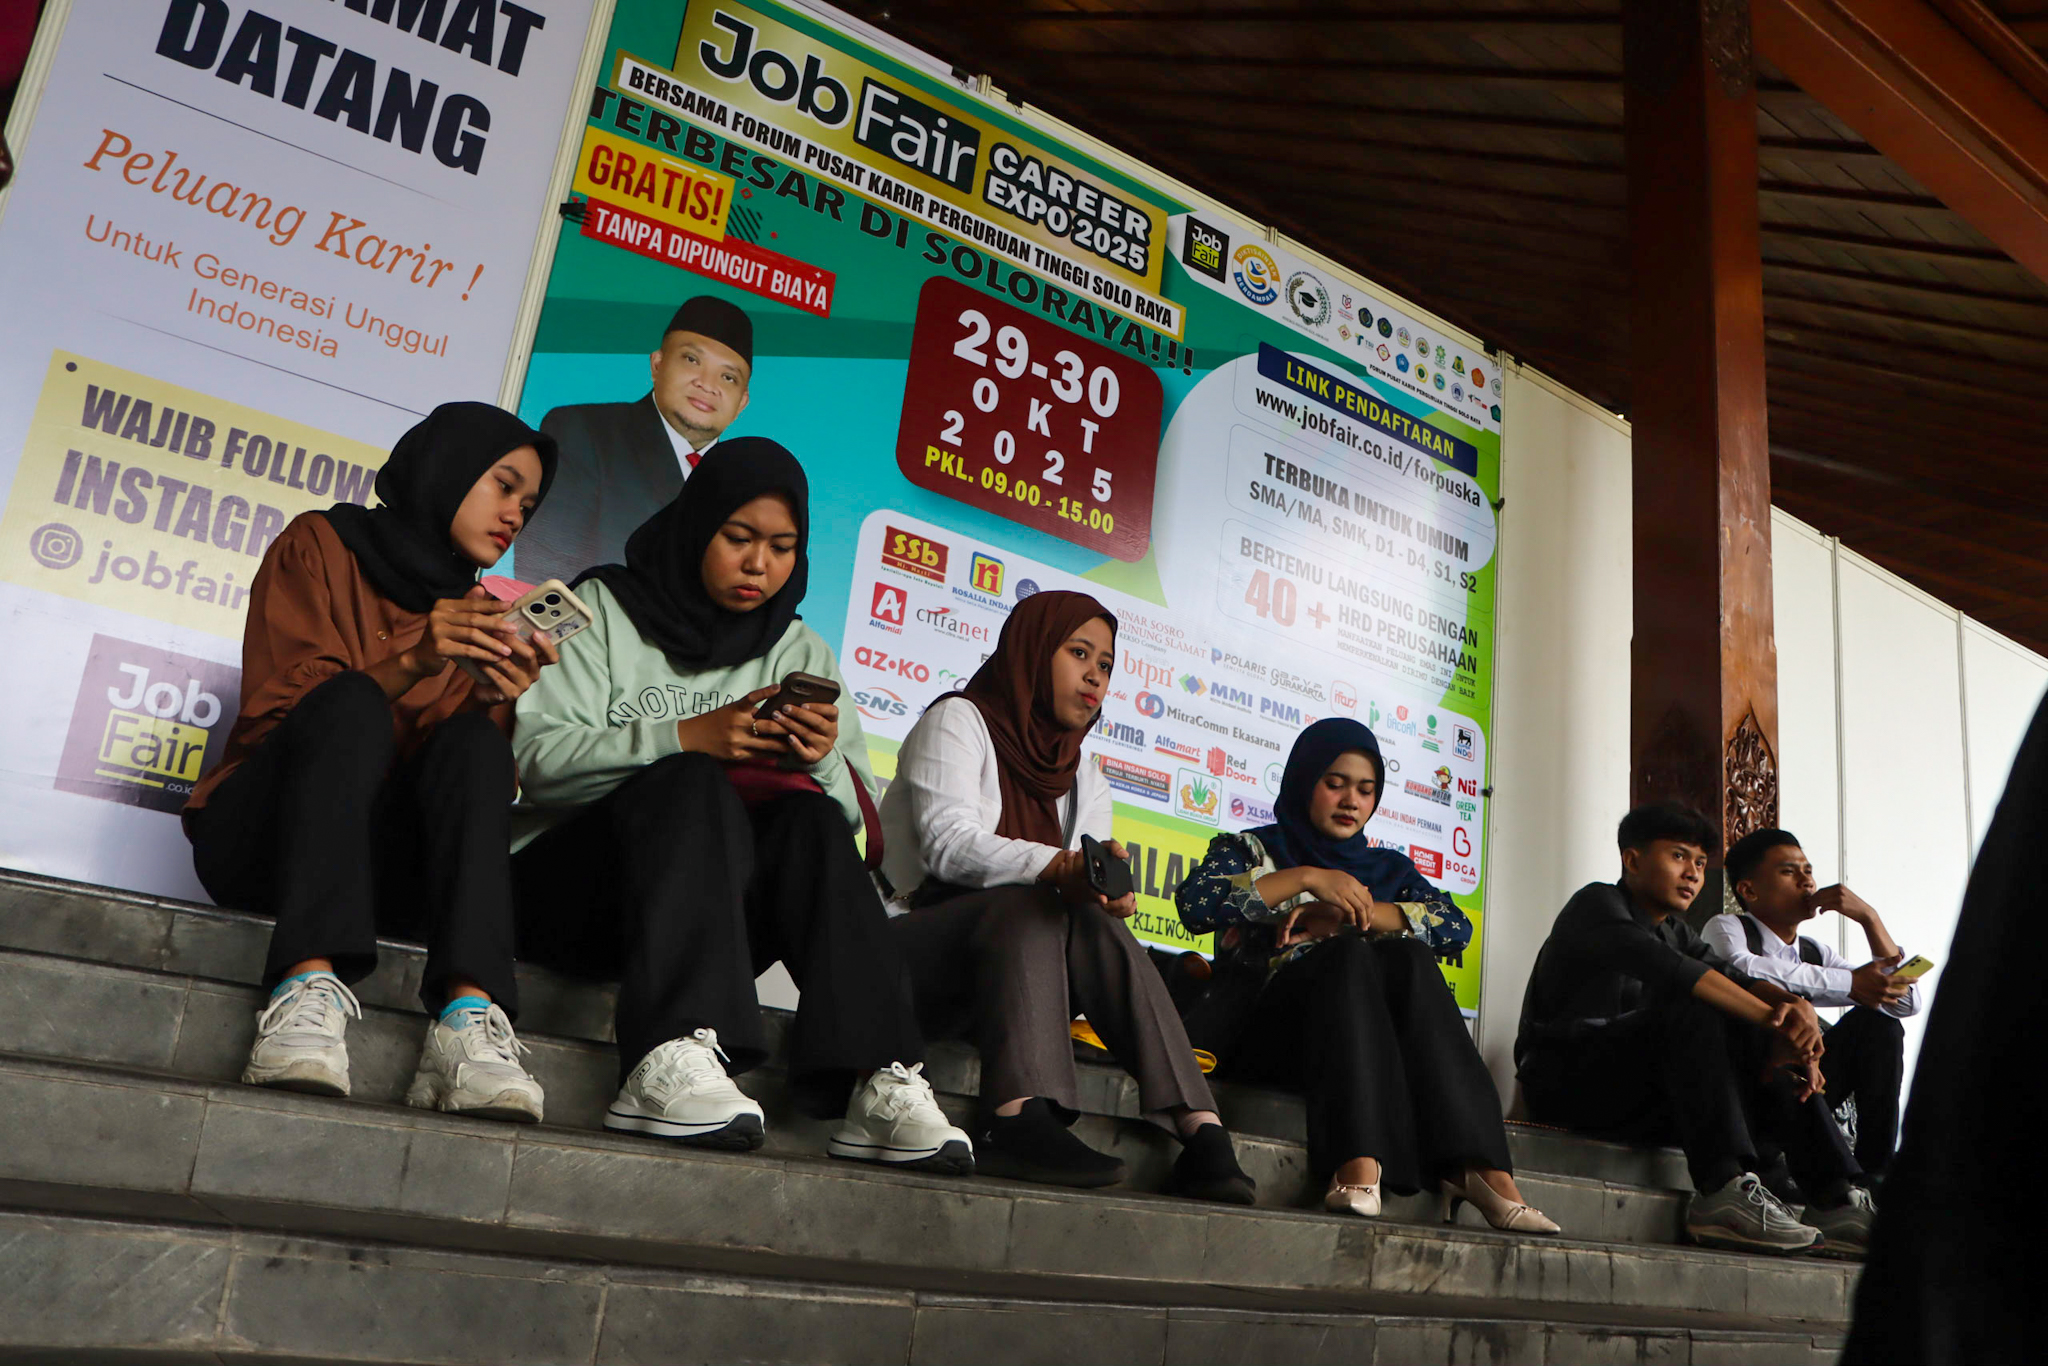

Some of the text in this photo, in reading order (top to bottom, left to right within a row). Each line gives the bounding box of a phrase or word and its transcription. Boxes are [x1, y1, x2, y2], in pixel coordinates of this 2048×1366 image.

[329, 0, 546, 77] MAT
[155, 0, 491, 176] DATANG
[700, 10, 976, 184] Job Fair
[588, 144, 724, 227] GRATIS!
[629, 66, 1172, 328] BERSAMA FORUM PUSAT KARIR PERGURUAN TINGGI SOLO RAYA
[992, 147, 1149, 243] CAREER
[83, 129, 307, 247] Peluang
[315, 211, 454, 294] Karir
[590, 85, 1195, 376] TERBESAR DI SOLORAYA!!!
[987, 177, 1146, 271] EXPO 2025
[596, 207, 827, 311] TANPA DIPUNGUT BIAYA
[1192, 225, 1223, 252] Job
[1193, 240, 1219, 269] Fair
[85, 214, 449, 358] Untuk Generasi Unggul
[188, 287, 340, 358] Indonesia
[953, 309, 1120, 418] 29-30
[1286, 361, 1455, 460] LINK PENDAFTARAN
[81, 384, 378, 507] WAJIB FOLLOW
[1255, 388, 1481, 508] www.jobfair.co.id/forpuska
[924, 444, 975, 483] PKL.
[981, 466, 1041, 507] 09.00
[1057, 496, 1115, 534] 15.00
[1264, 452, 1469, 561] TERBUKA UNTUK UMUM
[1250, 480, 1478, 594] SMA/MA, SMK, D1 D4, S1, S2
[952, 586, 987, 604] ROSALIA
[1240, 536, 1478, 649] BERTEMU LANGSUNG DENGAN
[1245, 568, 1298, 628] 40
[869, 619, 903, 635] Alfamidi
[916, 608, 989, 642] citranet
[1116, 608, 1185, 639] SINAR SOSRO
[1118, 633, 1167, 654] REKSO Company
[1338, 604, 1477, 674] HRD PERUSAHAAN
[1165, 637, 1208, 659] SLAMAT
[1223, 653, 1267, 676] POLARIS
[108, 662, 222, 728] Job
[1420, 659, 1436, 672] EMAS
[1440, 667, 1452, 678] INI
[1456, 673, 1476, 687] UNTUK
[1431, 676, 1456, 692] DENGAN
[1459, 686, 1476, 699] BAIK
[853, 691, 908, 716] SNS
[1210, 681, 1253, 708] MMI
[1260, 696, 1300, 725] PNM
[103, 713, 203, 775] Fair
[1155, 734, 1201, 757] Alfamart
[1167, 704, 1229, 736] MitraComm
[1232, 726, 1281, 752] Ekasarana
[1106, 758, 1123, 770] BINA
[1124, 764, 1147, 776] INSANI
[1147, 771, 1166, 782] SOLO
[1227, 754, 1247, 770] Red
[1455, 747, 1472, 759] INDO
[1226, 767, 1257, 786] Doorz
[1399, 812, 1417, 826] INDAH
[1417, 818, 1442, 834] PERMANA
[1455, 800, 1477, 813] GREEN
[1459, 811, 1472, 822] TEA
[1413, 849, 1434, 861] HOME
[1413, 856, 1436, 869] CREDIT
[1445, 859, 1476, 877] BOGA
[1460, 876, 1476, 885] GROUP
